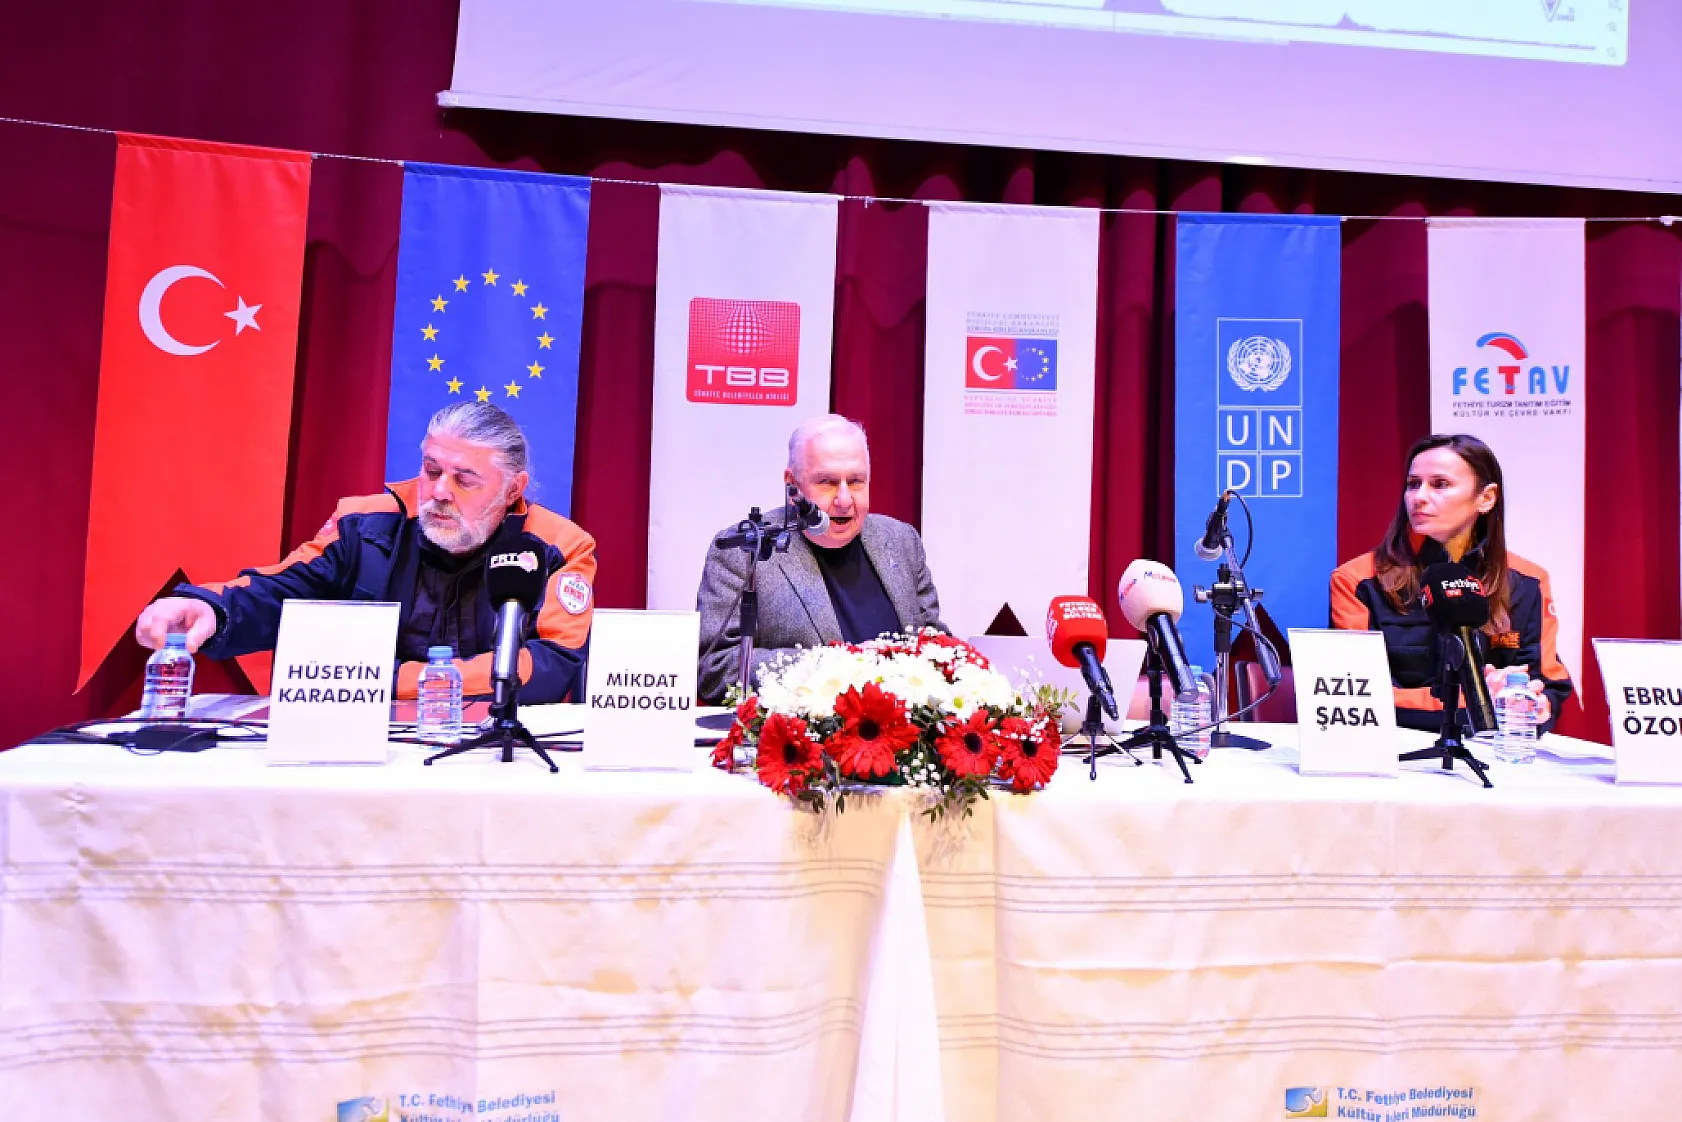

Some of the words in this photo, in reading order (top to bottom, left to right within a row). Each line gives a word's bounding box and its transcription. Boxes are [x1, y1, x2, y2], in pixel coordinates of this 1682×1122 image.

[694, 364, 789, 387] TBB
[1453, 365, 1569, 394] FETAV
[288, 661, 380, 680] HÜSEYİN
[607, 669, 678, 688] MİKDAT
[1314, 672, 1371, 696] AZİZ
[279, 688, 385, 703] KARADAYI
[591, 692, 690, 711] KADIOĞLU
[1623, 687, 1682, 706] EBRU
[1316, 706, 1379, 731] ŞASA
[1623, 710, 1682, 736] ÖZO
[399, 1094, 424, 1107] T.C.
[478, 1090, 556, 1112] Belediyesi
[1337, 1087, 1361, 1101] T.C.
[1410, 1086, 1473, 1101] Belediyesi
[1412, 1104, 1476, 1119] Müdürlüğü
